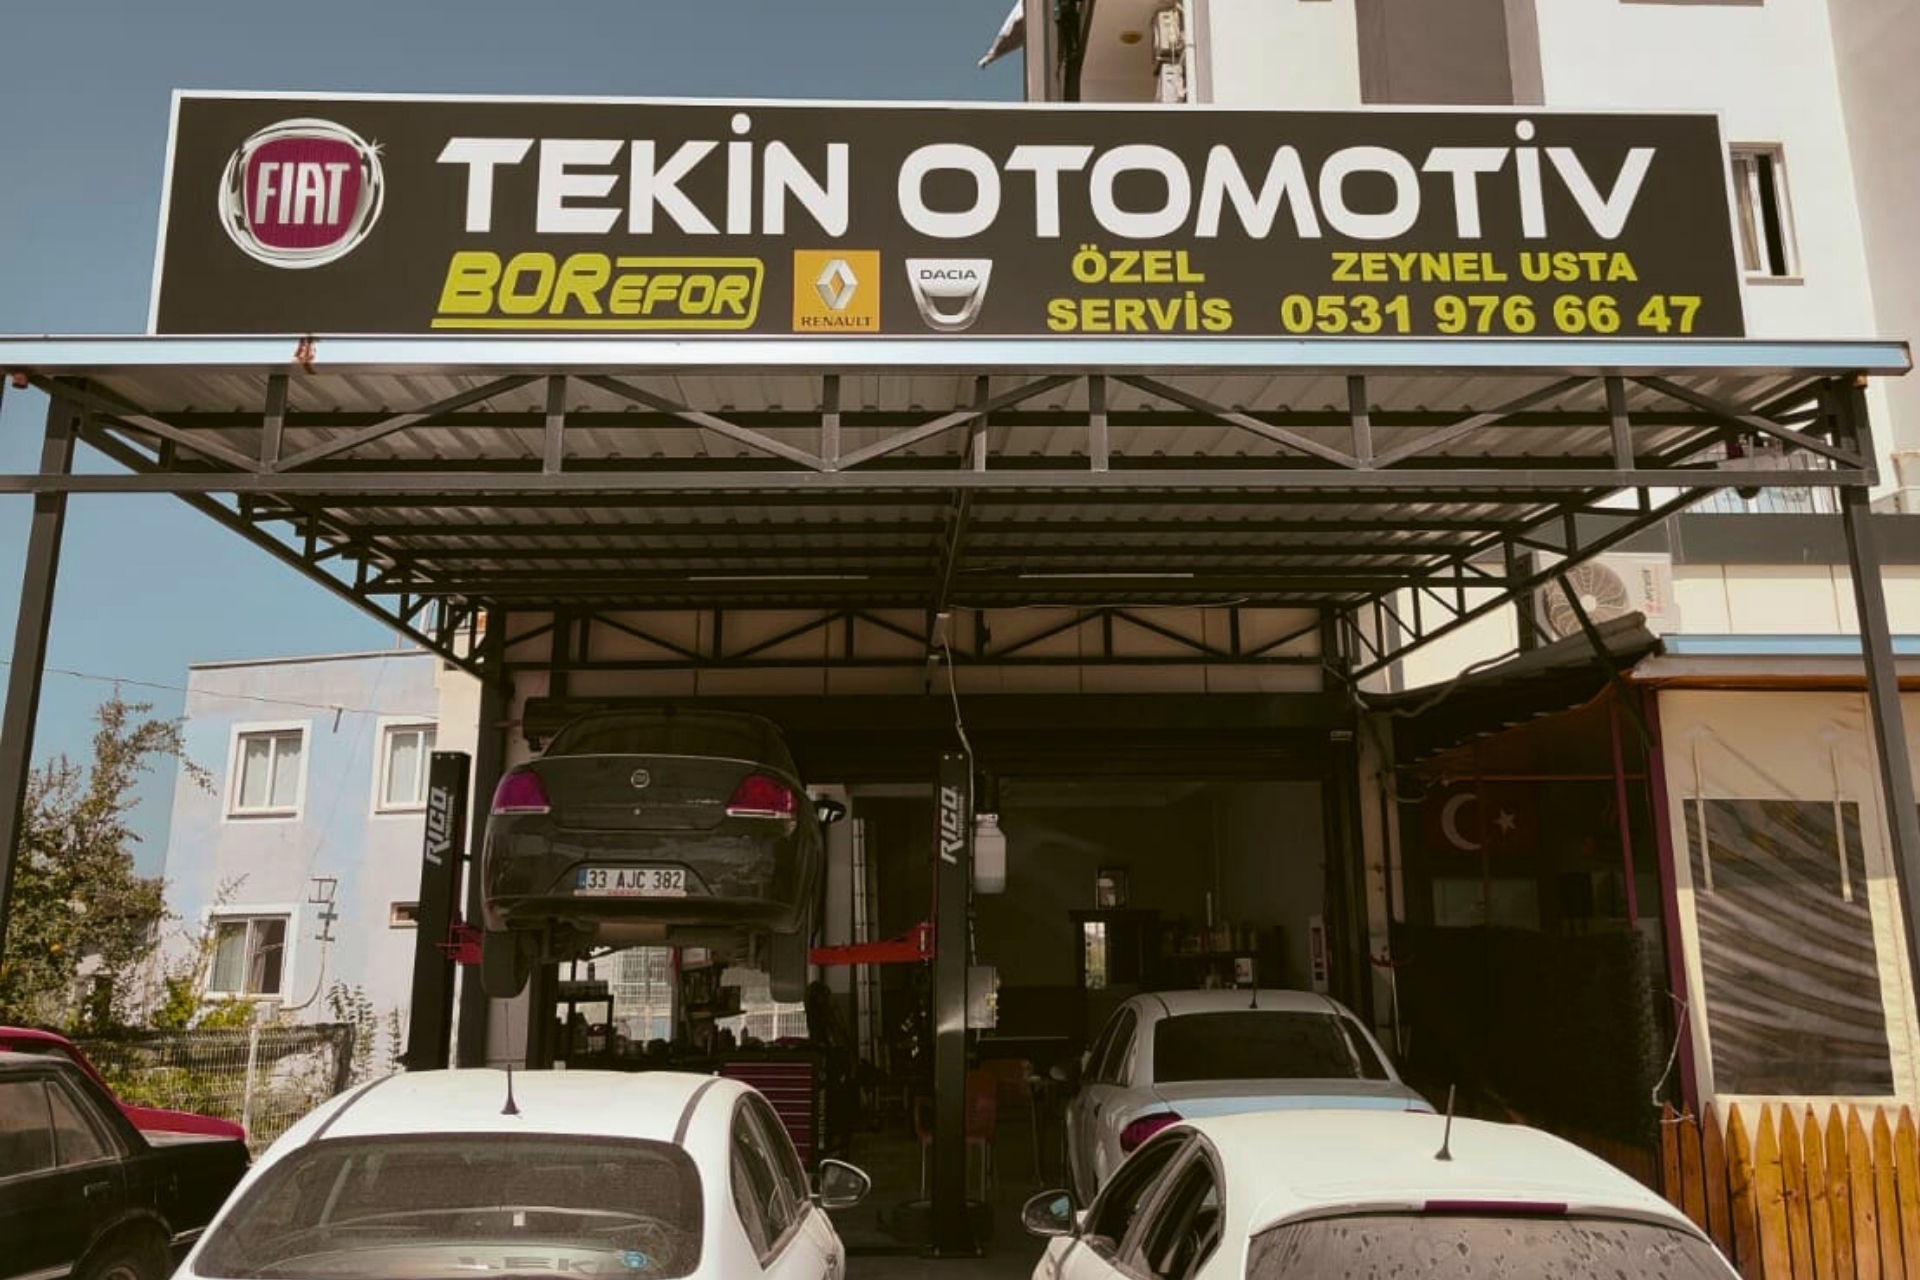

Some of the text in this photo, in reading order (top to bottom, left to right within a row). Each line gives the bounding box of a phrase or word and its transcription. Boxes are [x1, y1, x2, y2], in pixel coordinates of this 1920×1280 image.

[254, 162, 351, 225] FIAT
[436, 113, 1656, 240] TEKİN OTOMOTİV
[920, 269, 977, 280] DACIA
[1071, 244, 1206, 284] ÖZEL
[1331, 251, 1639, 282] ZEYNEL USTA
[801, 315, 873, 327] RENAULT
[1047, 290, 1233, 332] SERVİS
[1280, 294, 1702, 334] 0531 976 66 47
[426, 786, 450, 866] RICO
[941, 786, 963, 864] RICO
[588, 869, 683, 889] 33 AJC 382
